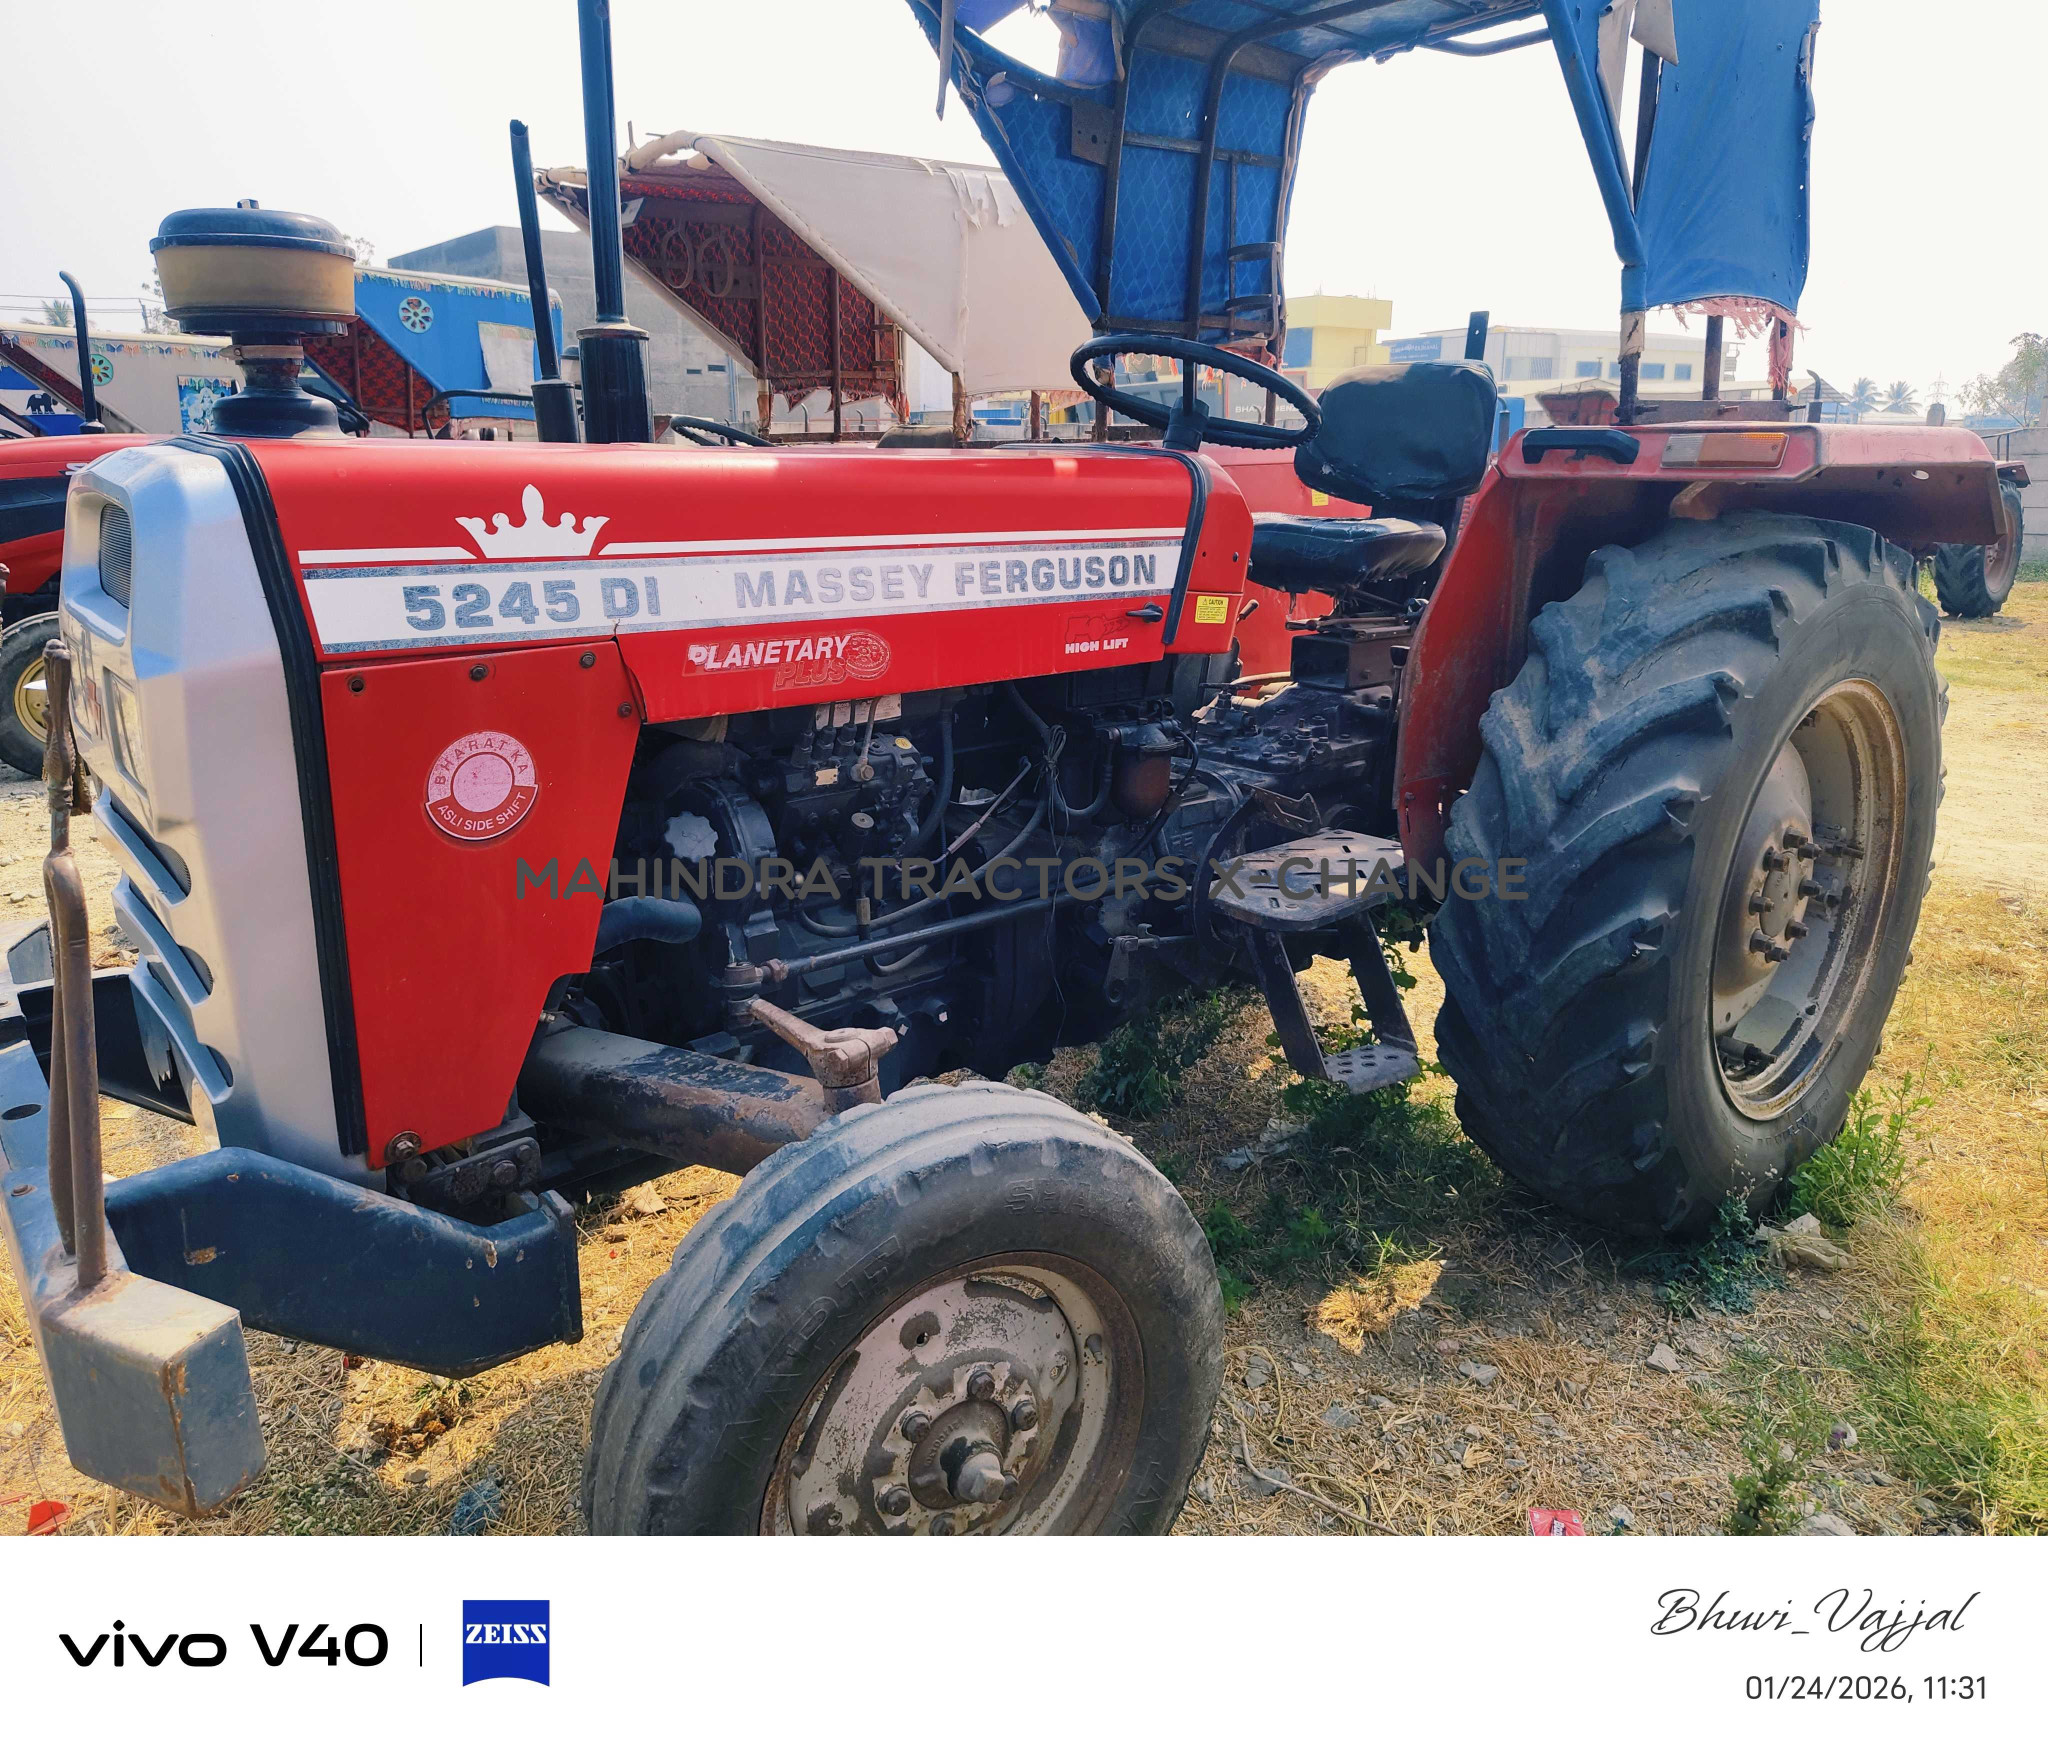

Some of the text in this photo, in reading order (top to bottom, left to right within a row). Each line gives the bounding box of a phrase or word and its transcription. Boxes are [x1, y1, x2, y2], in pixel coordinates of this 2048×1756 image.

[402, 553, 1157, 632] 5245 DI MASSEY FERGUSON
[687, 634, 852, 671] PLANETARY
[1064, 637, 1129, 654] HIGH LIFT
[775, 656, 847, 687] PLUS
[434, 737, 529, 785] BHARAT KA
[437, 791, 527, 831] ASLI SIDE SHIFT
